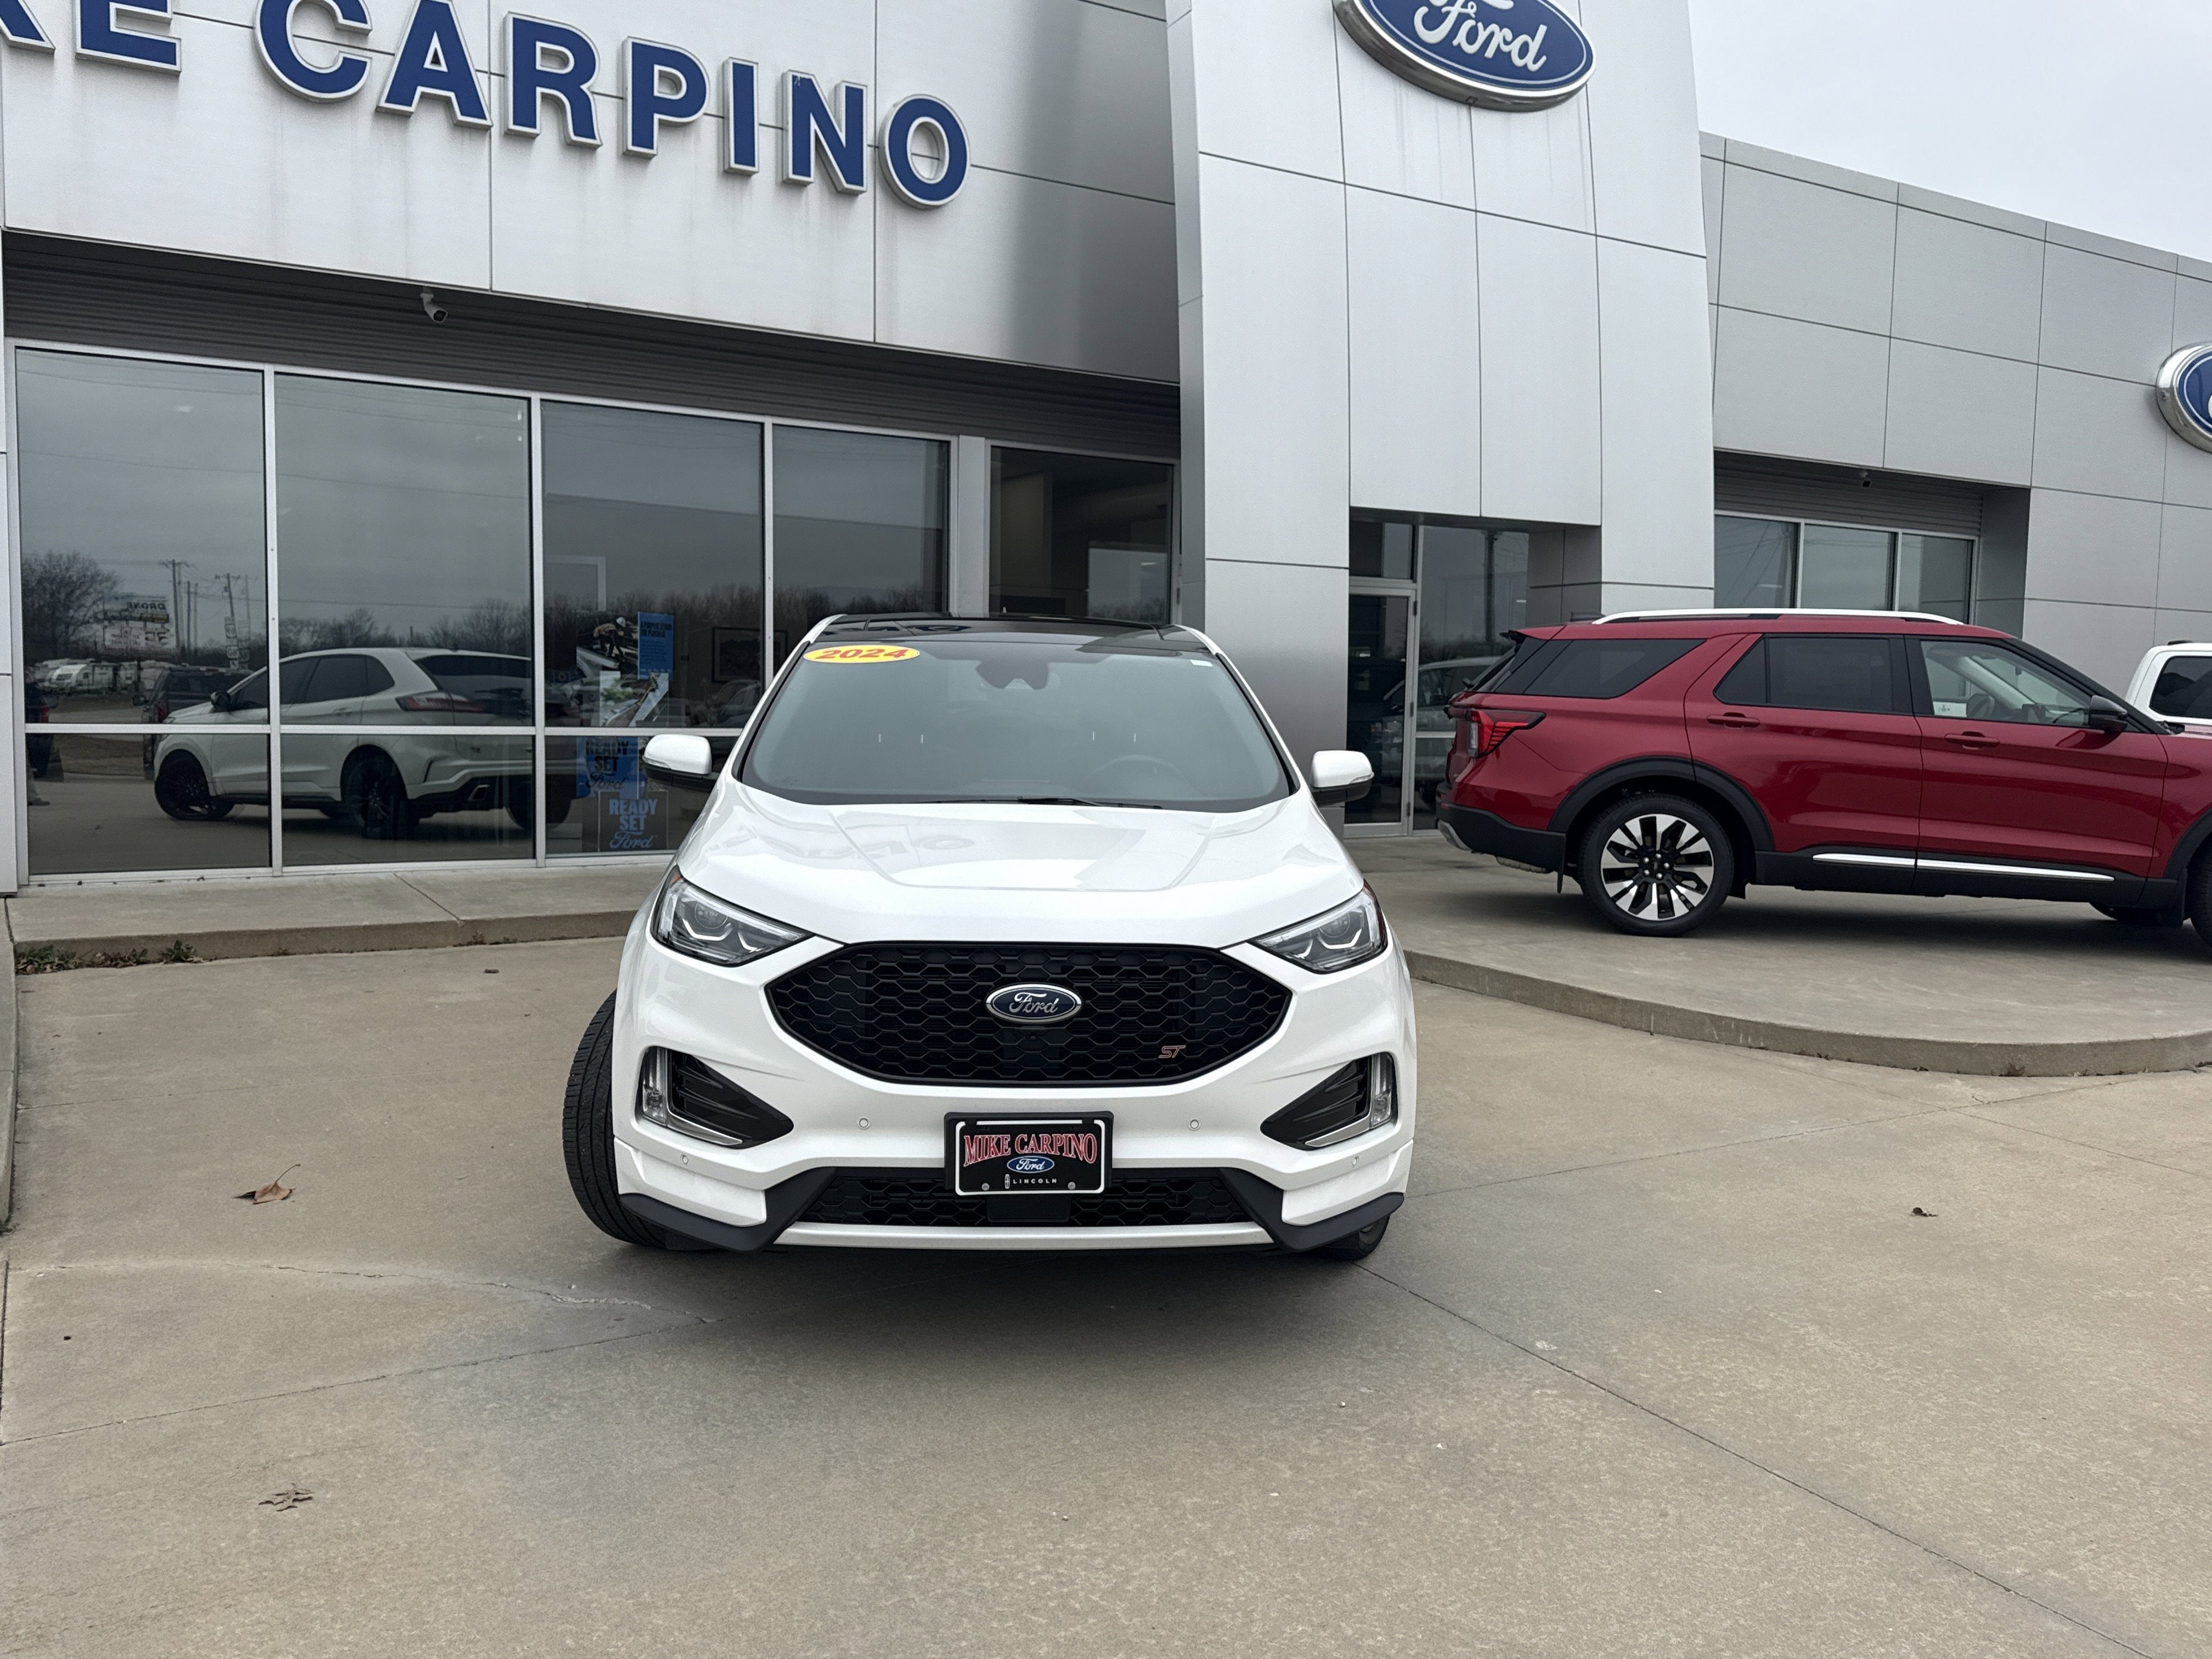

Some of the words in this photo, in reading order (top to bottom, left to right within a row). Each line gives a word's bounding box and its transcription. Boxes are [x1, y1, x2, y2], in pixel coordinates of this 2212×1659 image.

[1414, 0, 1548, 72] Ford
[253, 0, 971, 209] CARPINO
[815, 648, 909, 659] 2024
[586, 739, 629, 755] READY
[595, 755, 619, 772] SET
[609, 799, 657, 815] READY
[619, 815, 646, 831] SET
[610, 830, 654, 848] Ford
[1009, 992, 1059, 1013] Ford
[1158, 1045, 1186, 1059] ST
[963, 1134, 1011, 1167] MIKE
[1015, 1133, 1097, 1164] CARPINO
[1015, 1158, 1045, 1170] Ford
